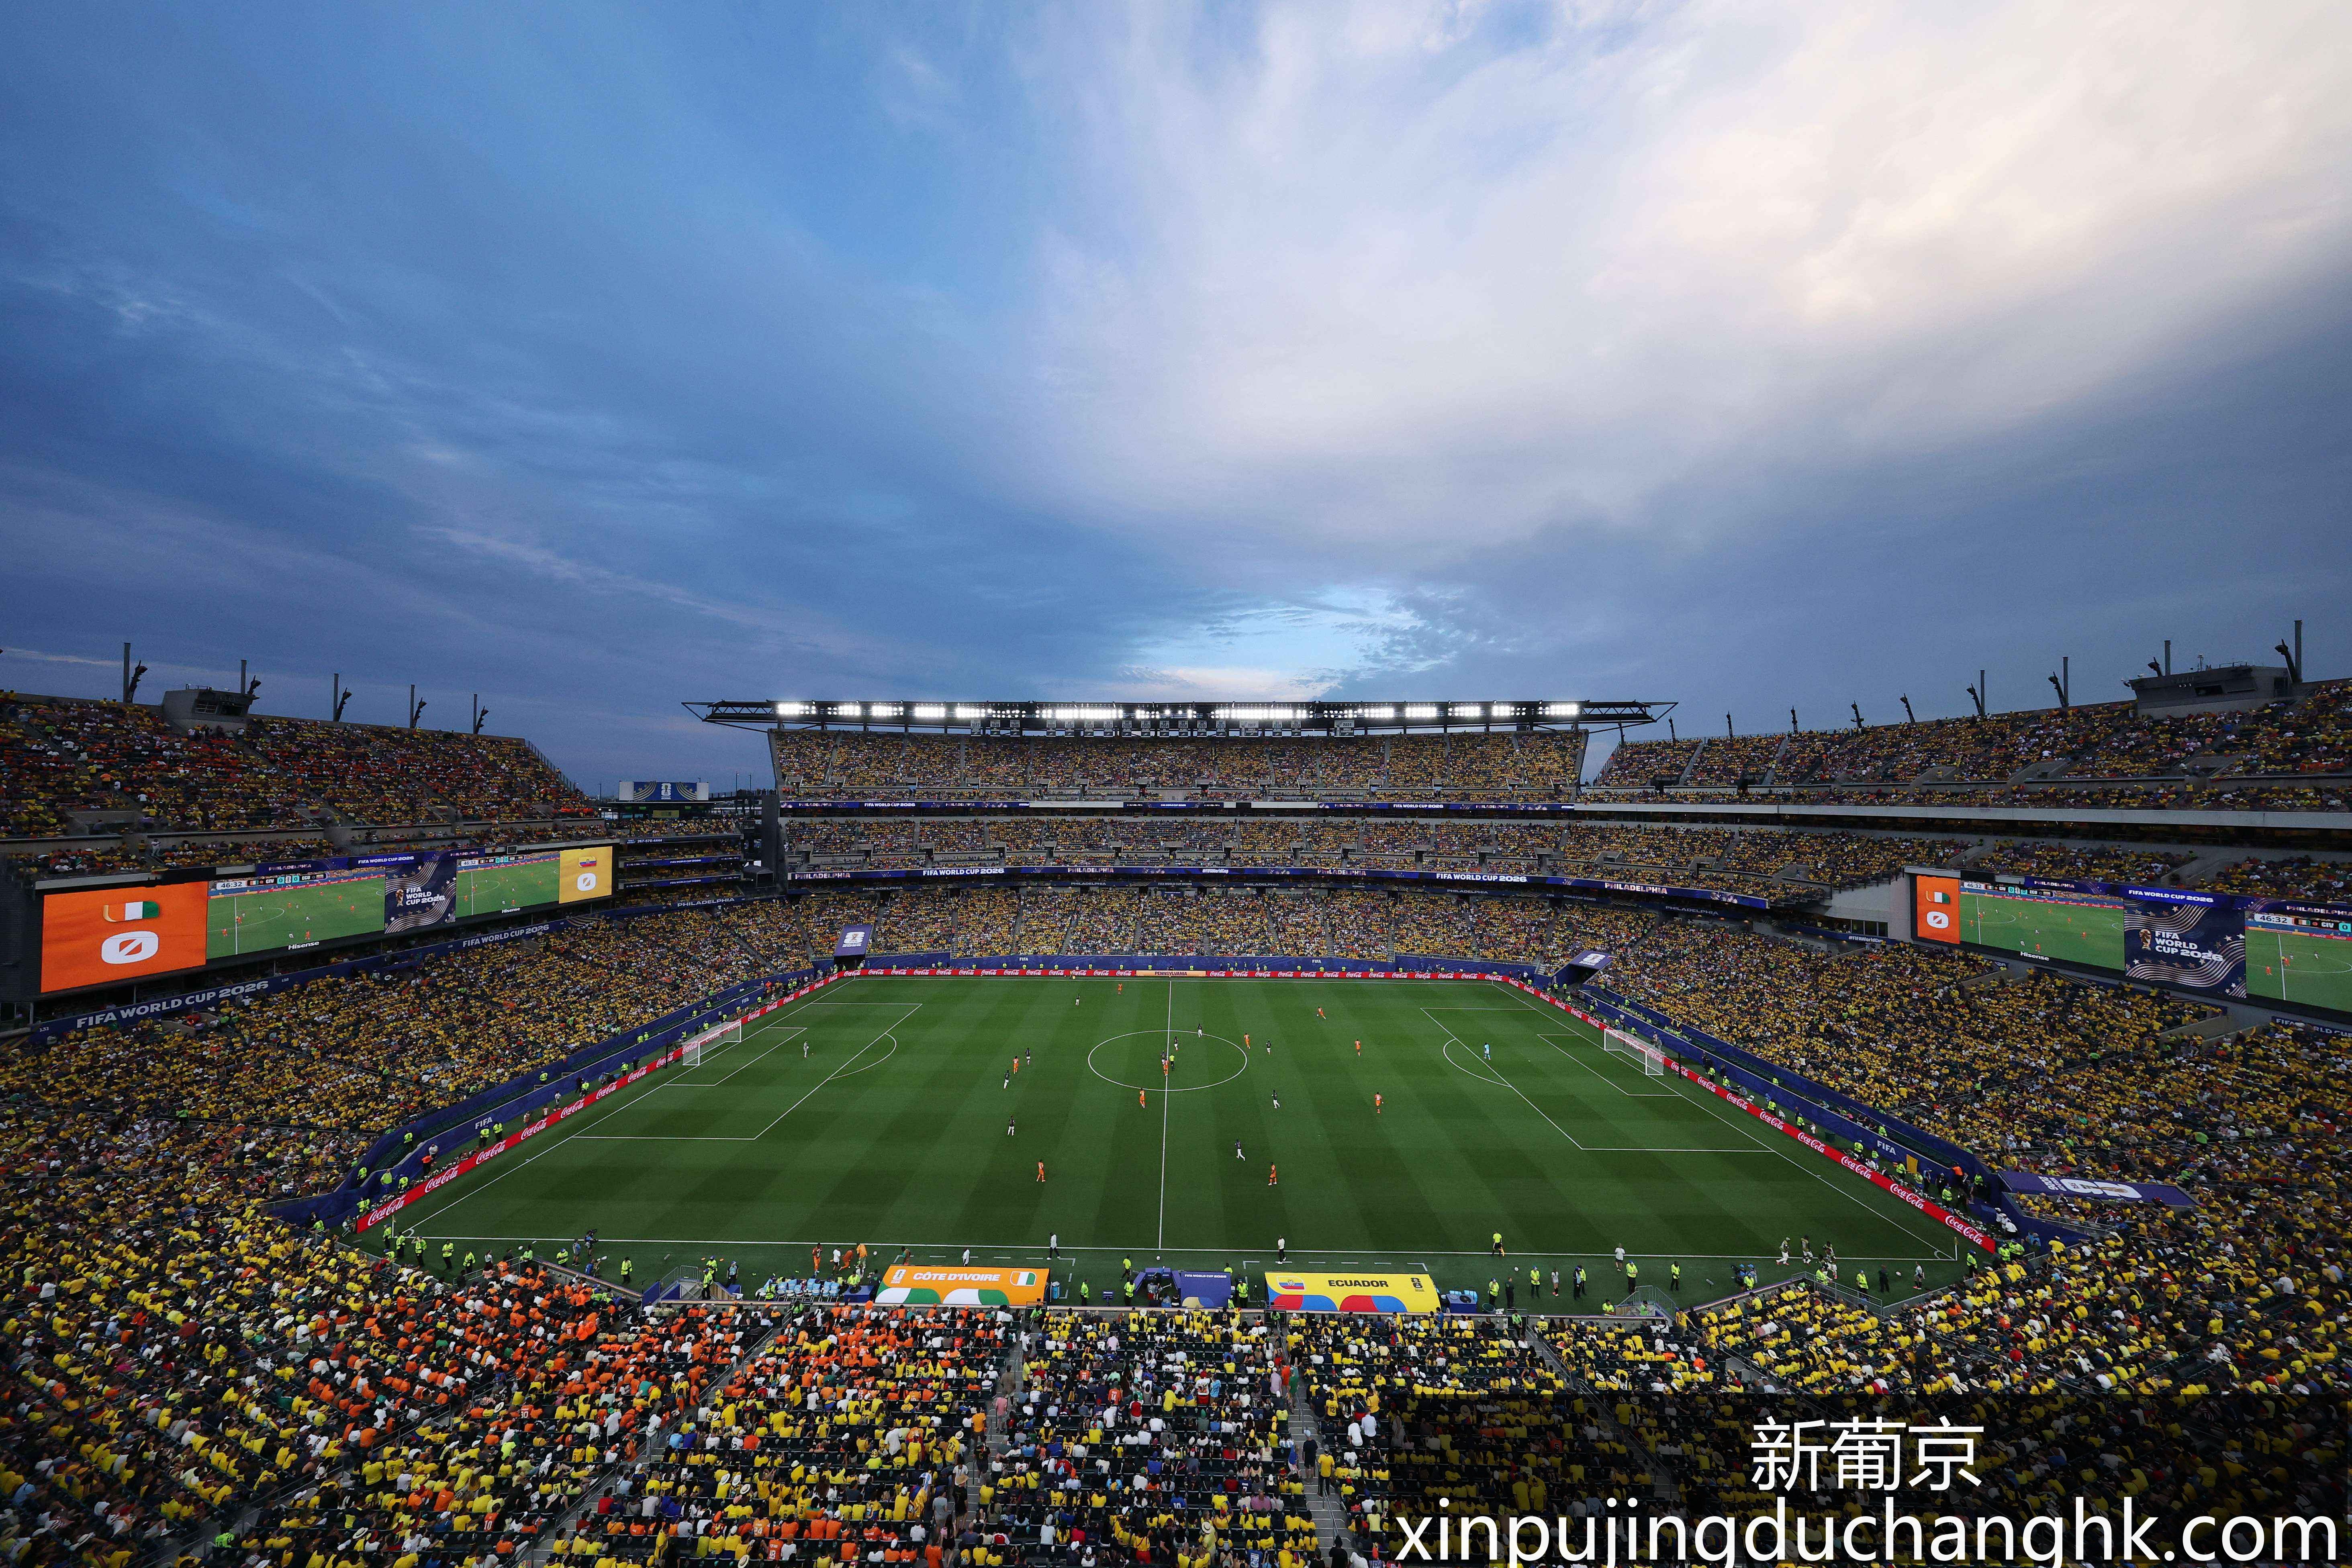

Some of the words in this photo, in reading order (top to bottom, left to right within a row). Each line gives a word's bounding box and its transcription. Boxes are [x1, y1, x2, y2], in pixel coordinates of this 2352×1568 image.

[1604, 882, 1668, 895] PHILADELPHIA
[2034, 880, 2075, 888] PHILADELPHIA
[406, 891, 432, 900] WORLD
[421, 895, 445, 904] 2026
[677, 898, 735, 907] PHILADELPHIA
[1665, 905, 1719, 916] PHILADELPHIA
[2260, 915, 2288, 923] 46:32
[462, 938, 480, 947] FIFA
[482, 932, 509, 943] WORLD
[510, 929, 525, 937] CUP
[525, 924, 550, 935] 2026
[2155, 931, 2180, 940] FIFA
[288, 941, 320, 950] Hisense
[2155, 937, 2198, 950] WORLD
[2020, 951, 2050, 961] Hisense
[2156, 945, 2178, 954] CUP
[2180, 949, 2224, 962] 2026
[814, 980, 824, 989] Coca-Cola
[1508, 978, 1519, 988] Coca-Cola
[783, 994, 795, 1004] Coca-Cola
[1540, 992, 1550, 1002] Coca-Cola
[77, 1012, 117, 1029] FIFA
[120, 999, 182, 1019] WORLD
[185, 991, 217, 1005] CUP
[219, 980, 269, 998] 2026
[748, 1010, 760, 1021] Coca-Cola
[1571, 1008, 1582, 1019] Coca-Cola
[628, 1066, 647, 1083] Coca-Cola
[596, 1081, 618, 1100] Coca-Cola
[1697, 1076, 1716, 1093] Coca-Cola
[560, 1098, 585, 1119] Coca-Cola
[1727, 1093, 1749, 1111] Coca-Cola
[474, 1116, 492, 1130] FIFA
[1759, 1111, 1784, 1131] Coca-Cola
[521, 1118, 548, 1140] Coca-Cola
[1798, 1132, 1825, 1154] Coca-Cola
[1877, 1139, 1896, 1156] FIFA
[476, 1139, 507, 1165] Coca-Cola
[1841, 1156, 1872, 1180] Coca-Cola
[425, 1164, 460, 1193] Coca-Cola
[1890, 1183, 1925, 1210] Coca-Cola
[367, 1193, 407, 1226] Coca-Cola
[1945, 1215, 1984, 1245] Coca-Cola
[913, 1271, 948, 1281] CÔTE
[948, 1273, 1001, 1282] D'IVOIRE
[1328, 1280, 1389, 1288] ECUADOR
[484, 1521, 492, 1530] 10
